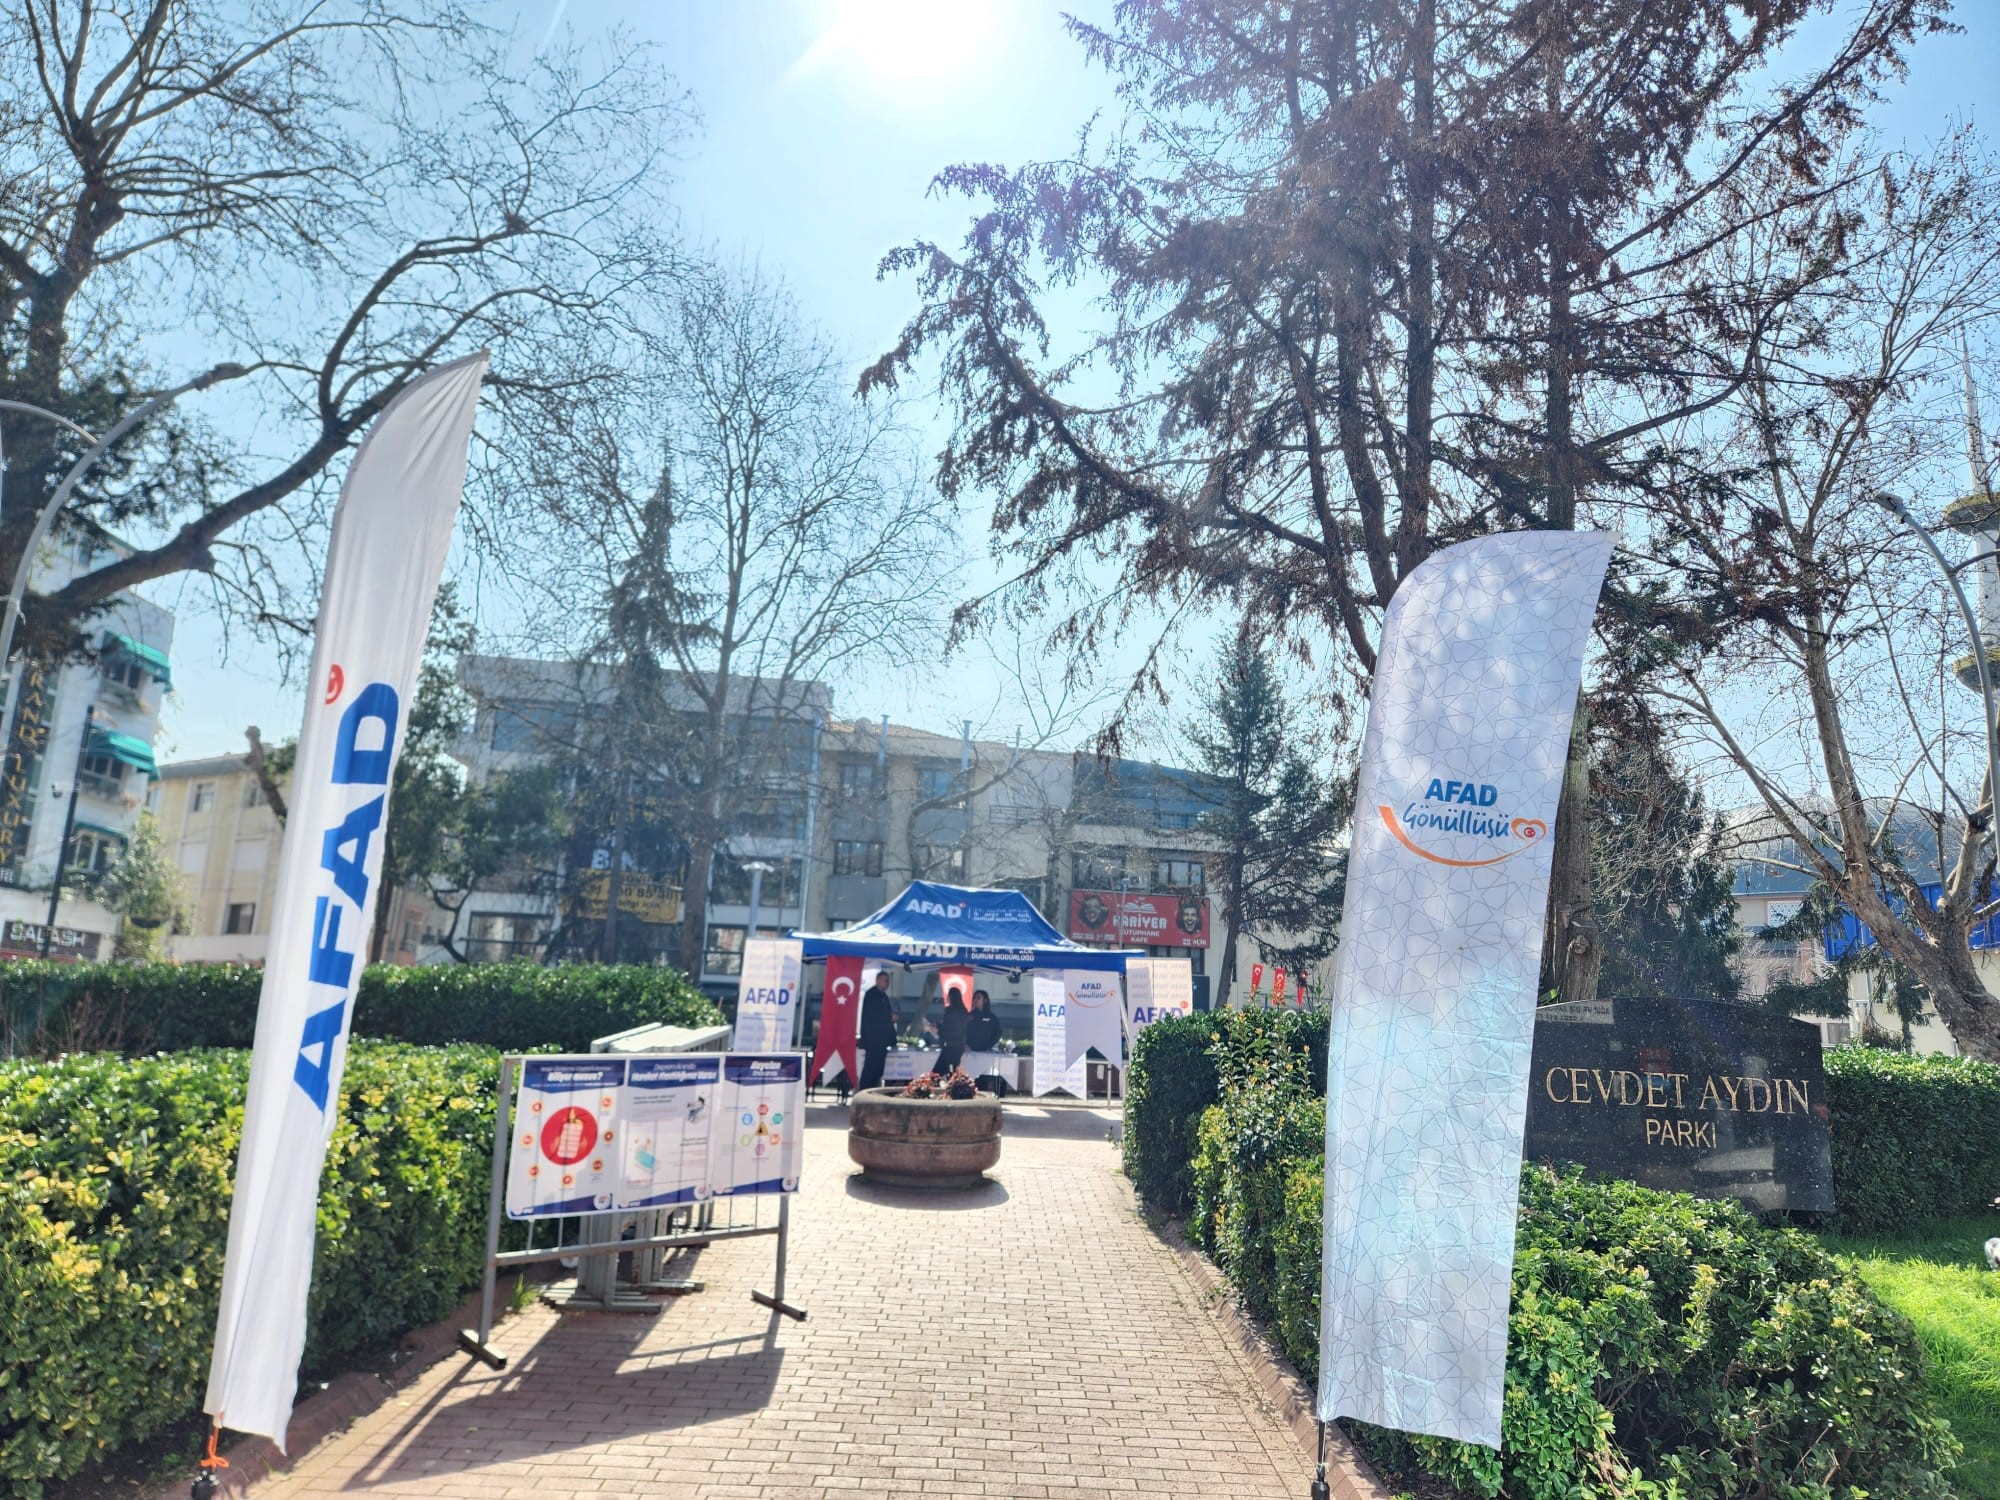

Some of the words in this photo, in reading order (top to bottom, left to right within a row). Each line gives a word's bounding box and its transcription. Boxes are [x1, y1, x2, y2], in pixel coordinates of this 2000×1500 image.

[1424, 778, 1498, 807] AFAD
[1403, 802, 1510, 839] Gönüllüsü
[294, 682, 399, 1113] AFAD
[905, 898, 962, 919] AFAD
[898, 943, 959, 958] AFAD
[744, 987, 790, 1006] AFAD
[1081, 982, 1102, 990] AFAD
[1037, 1003, 1065, 1018] AFA
[1546, 1066, 1690, 1110] CEVDET
[1700, 1074, 1810, 1115] AYDIN
[1645, 1118, 1718, 1149] PARKI
